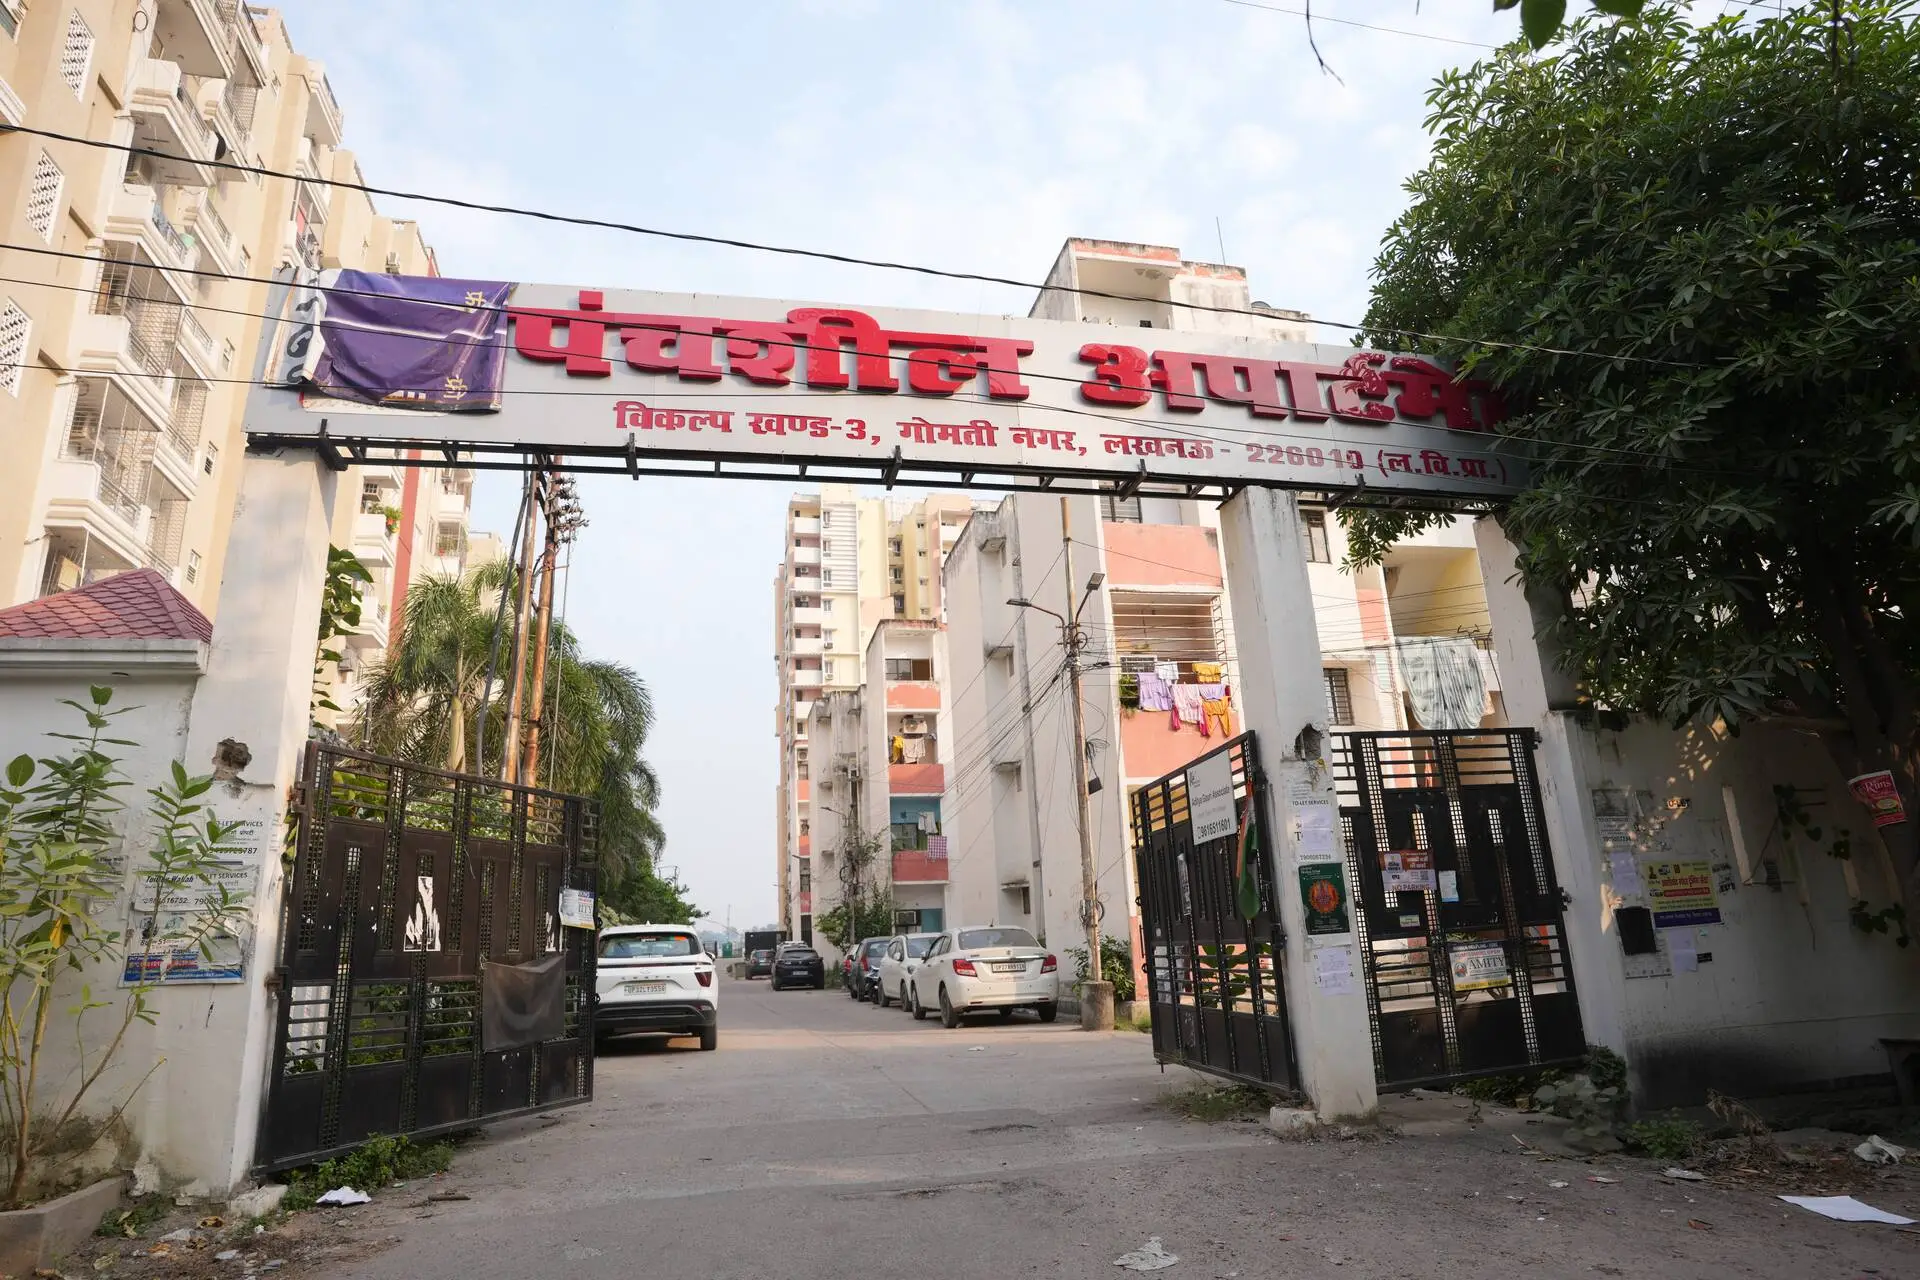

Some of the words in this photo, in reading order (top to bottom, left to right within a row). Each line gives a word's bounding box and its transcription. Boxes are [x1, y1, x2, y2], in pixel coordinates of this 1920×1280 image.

[507, 290, 1034, 400] पंचशील
[613, 400, 735, 433] विकल्प
[896, 417, 999, 447] गोमती
[1009, 427, 1087, 456] नगर,
[1099, 434, 1214, 459] लखनऊ
[1246, 442, 1364, 470] 226010
[1469, 957, 1504, 970] AMITY
